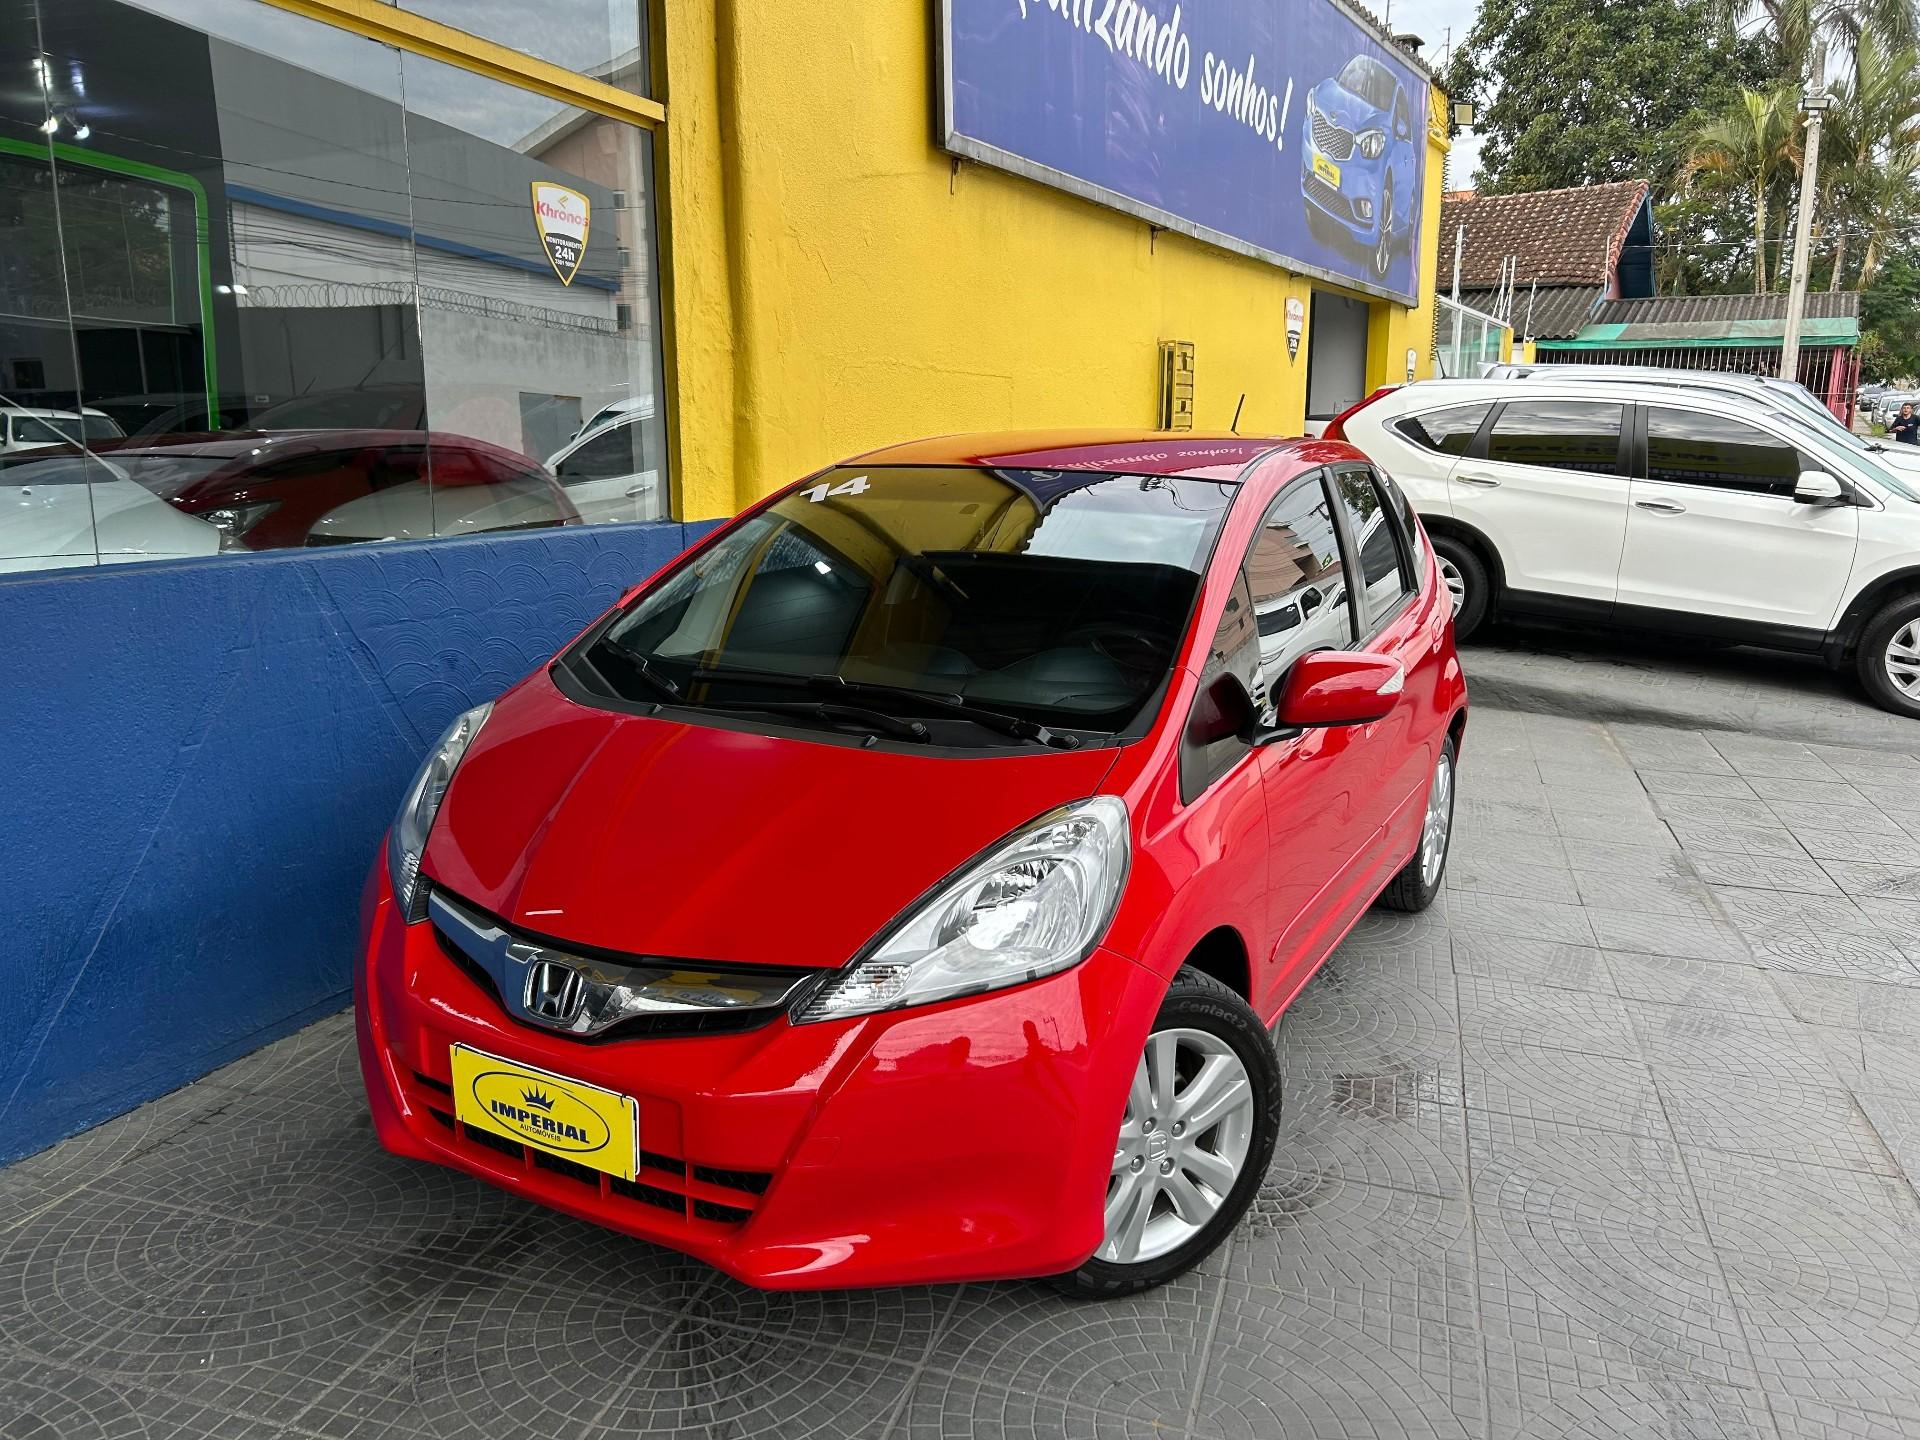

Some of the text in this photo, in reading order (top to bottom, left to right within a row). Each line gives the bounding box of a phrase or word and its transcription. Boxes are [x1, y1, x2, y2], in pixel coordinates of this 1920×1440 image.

[1200, 51, 1293, 151] sonhos!
[536, 201, 589, 227] Khronos
[555, 245, 575, 261] 24h
[799, 475, 871, 503] 14
[1179, 1000, 1238, 1025] Contact
[491, 1099, 590, 1144] IMPERIAL
